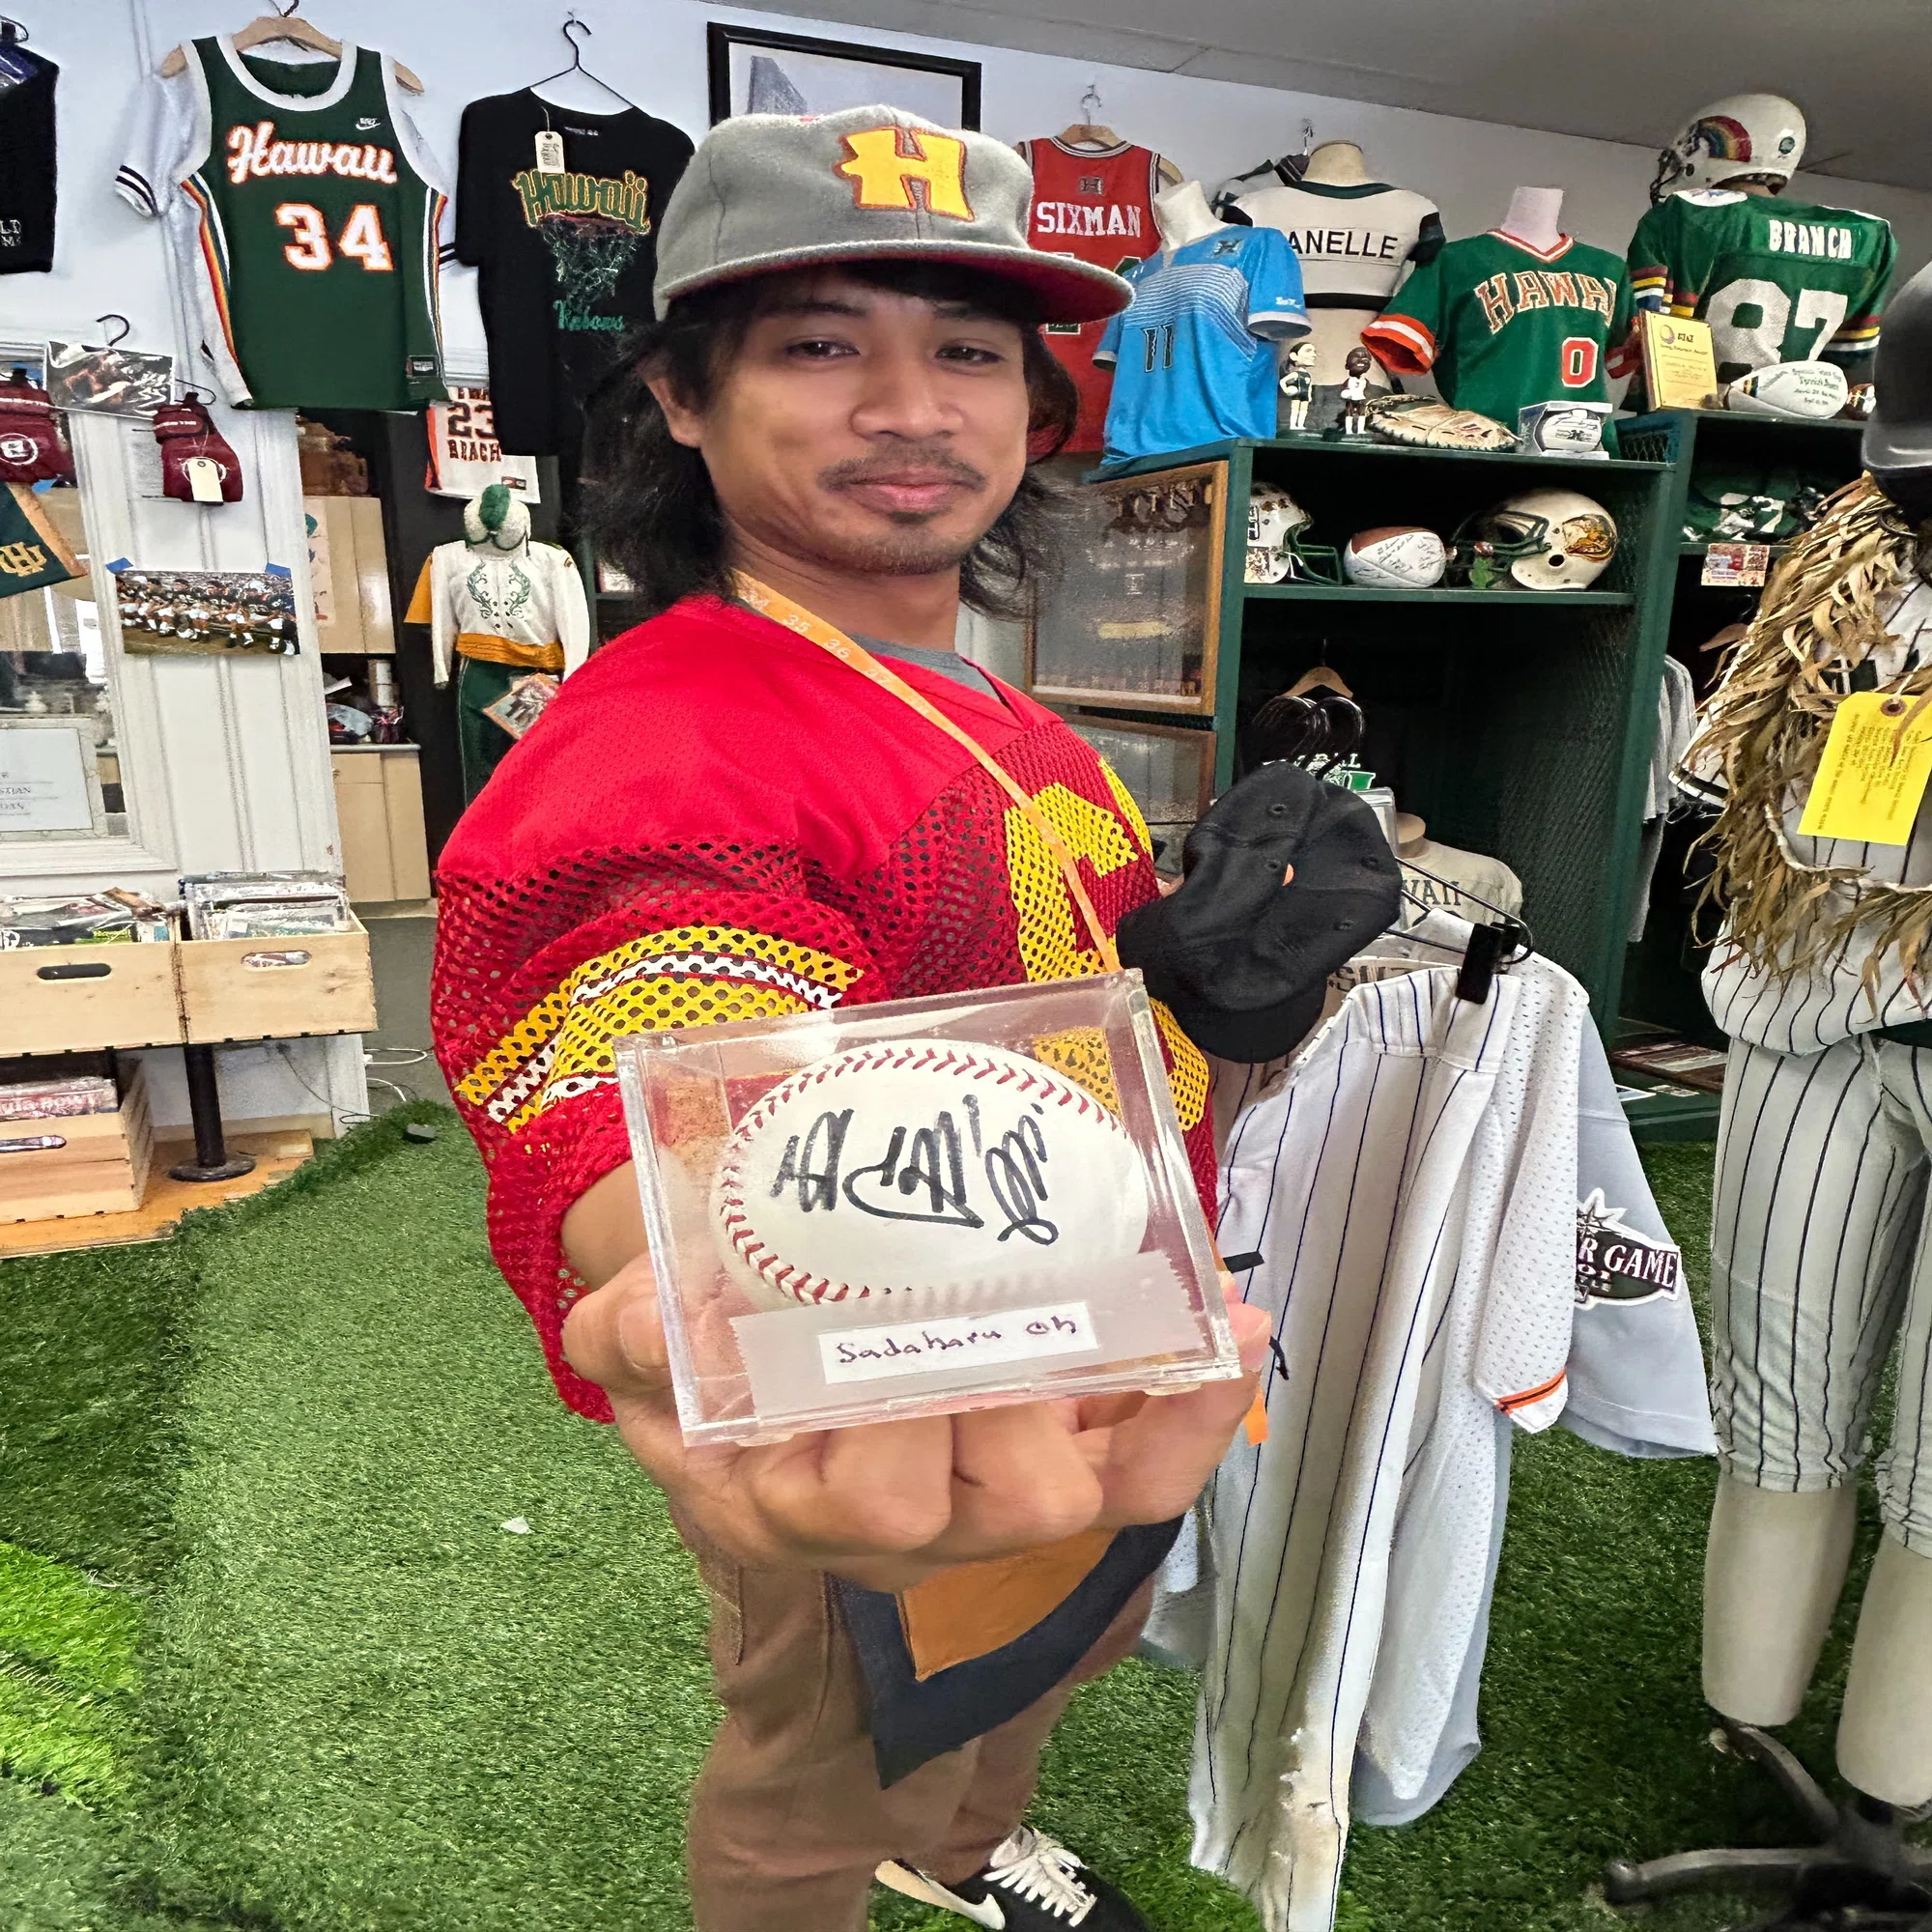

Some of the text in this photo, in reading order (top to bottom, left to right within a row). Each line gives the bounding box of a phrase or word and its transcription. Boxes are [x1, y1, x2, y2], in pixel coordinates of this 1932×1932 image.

[273, 201, 394, 272] 34
[1037, 201, 1141, 239] SIXMAN
[1769, 219, 1853, 260] BRANCH
[1140, 320, 1176, 373] 11
[1561, 337, 1600, 388] 0
[783, 614, 811, 634] 35
[823, 638, 850, 659] 36
[1604, 1244, 1677, 1288] GAME
[837, 1316, 1077, 1364] Sadaharu Oh
